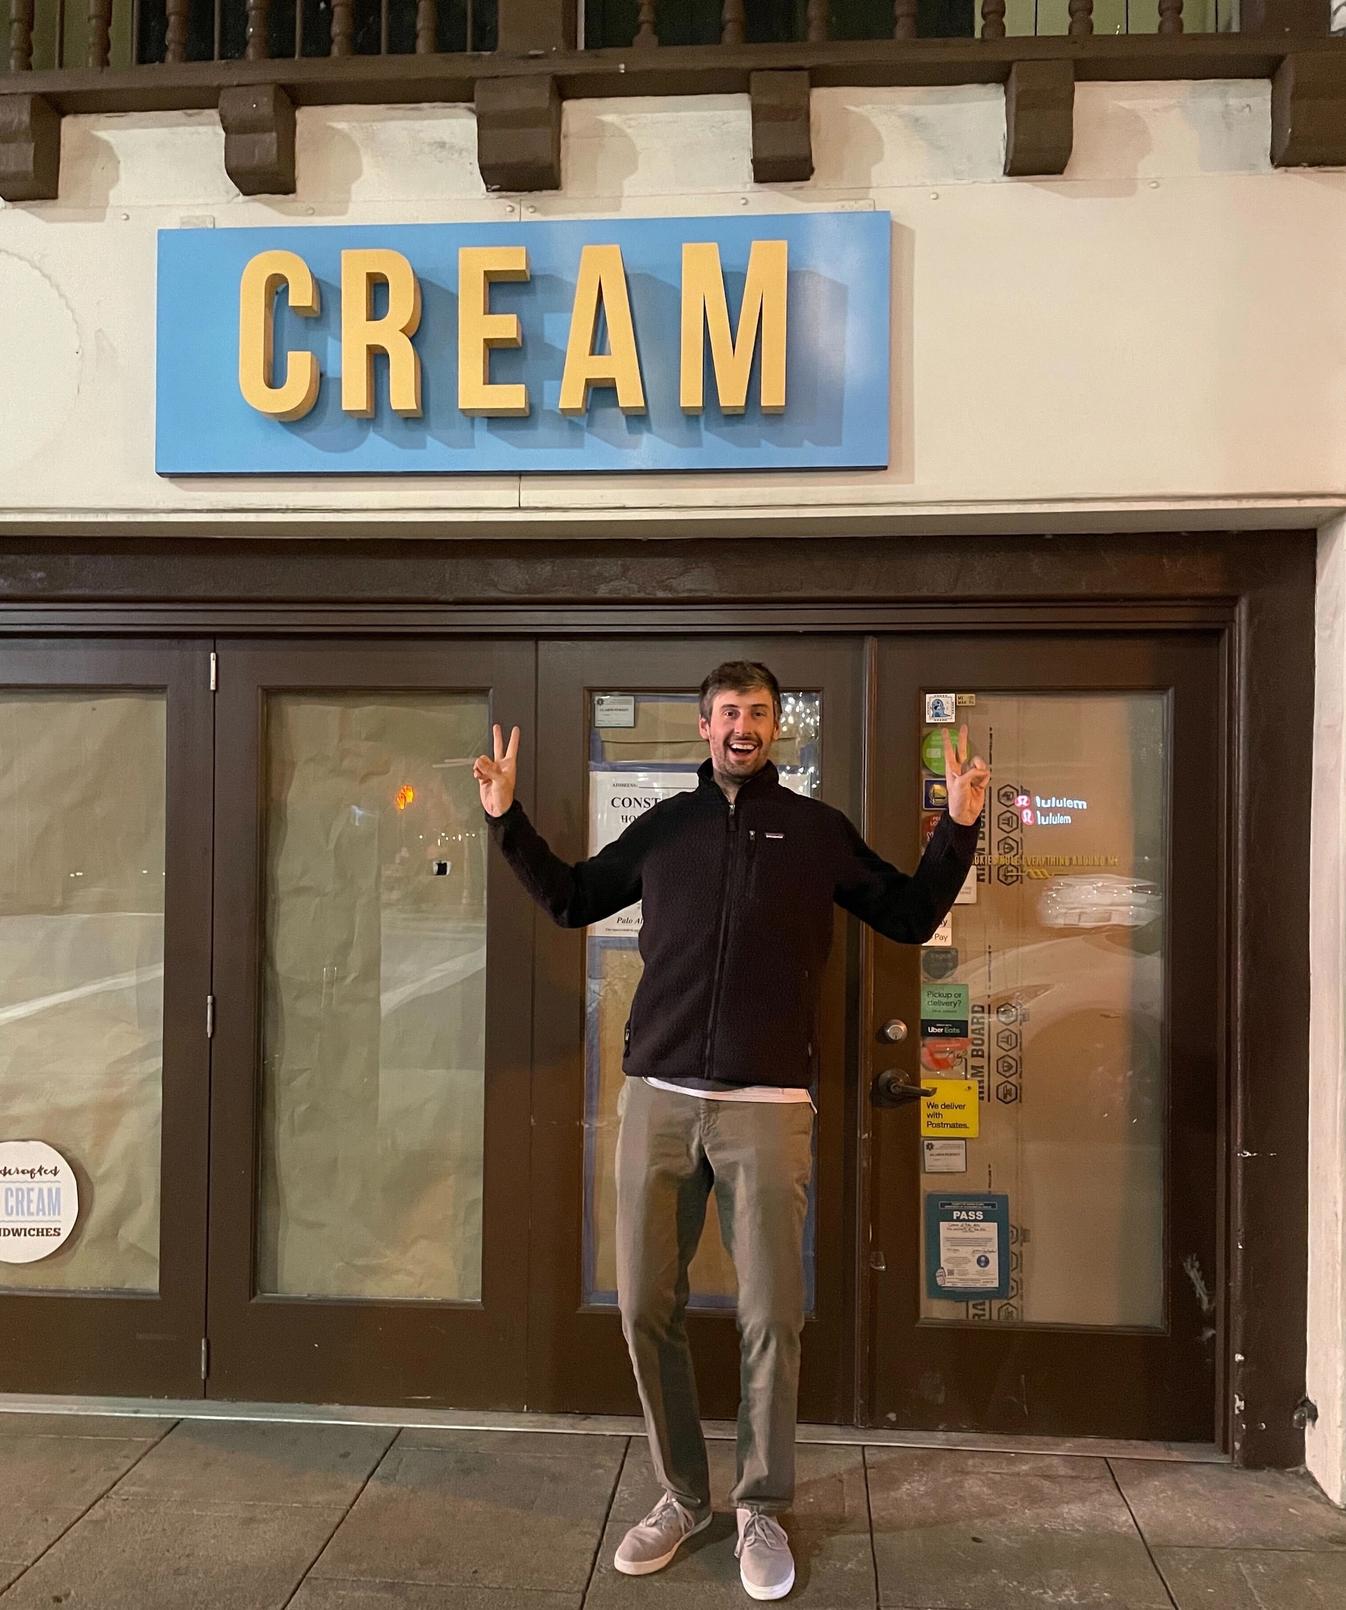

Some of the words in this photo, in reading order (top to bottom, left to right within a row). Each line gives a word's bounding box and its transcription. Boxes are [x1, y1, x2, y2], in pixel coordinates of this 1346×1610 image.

[238, 240, 788, 421] CREAM
[611, 796, 662, 809] CONST
[1022, 855, 1070, 866] EVERYTHING
[616, 916, 634, 924] Palo
[934, 933, 948, 942] Pay
[927, 991, 952, 999] Pickup
[927, 999, 962, 1008] delivery?
[944, 1026, 961, 1034] Eats
[971, 1004, 985, 1059] BOARD
[926, 1101, 939, 1109] We
[940, 1102, 966, 1110] deliver
[926, 1120, 970, 1129] Postmates.
[0, 1165, 61, 1179] dcrafted
[5, 1187, 61, 1217] CREAM
[953, 1210, 984, 1220] PASS
